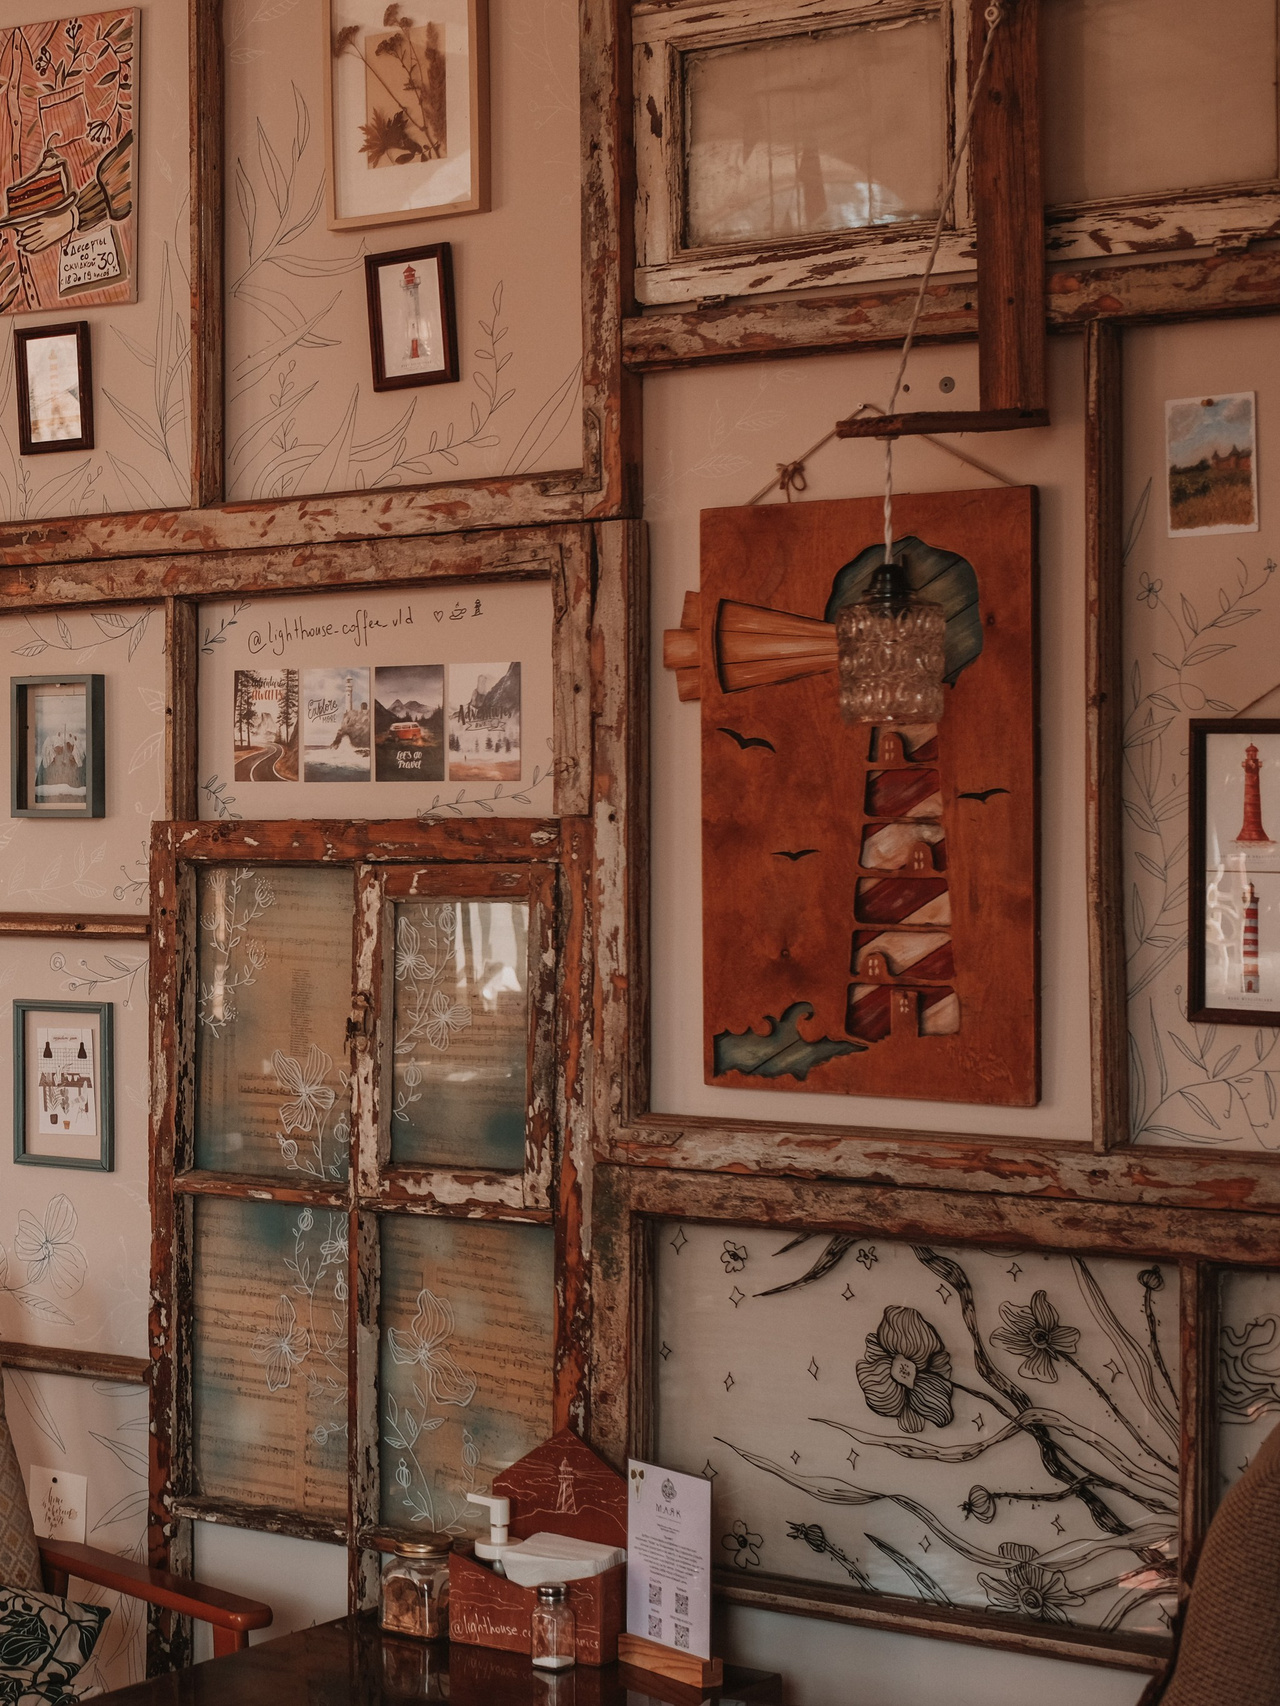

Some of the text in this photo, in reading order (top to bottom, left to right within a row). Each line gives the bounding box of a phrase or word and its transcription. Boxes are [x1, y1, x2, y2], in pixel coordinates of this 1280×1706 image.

[71, 238, 107, 256] Десерты
[97, 251, 115, 270] 30
[65, 274, 72, 285] 18
[307, 698, 339, 722] Explore
[322, 714, 337, 723] MORE
[397, 760, 422, 769] Travel
[655, 1503, 682, 1519] МАЯК
